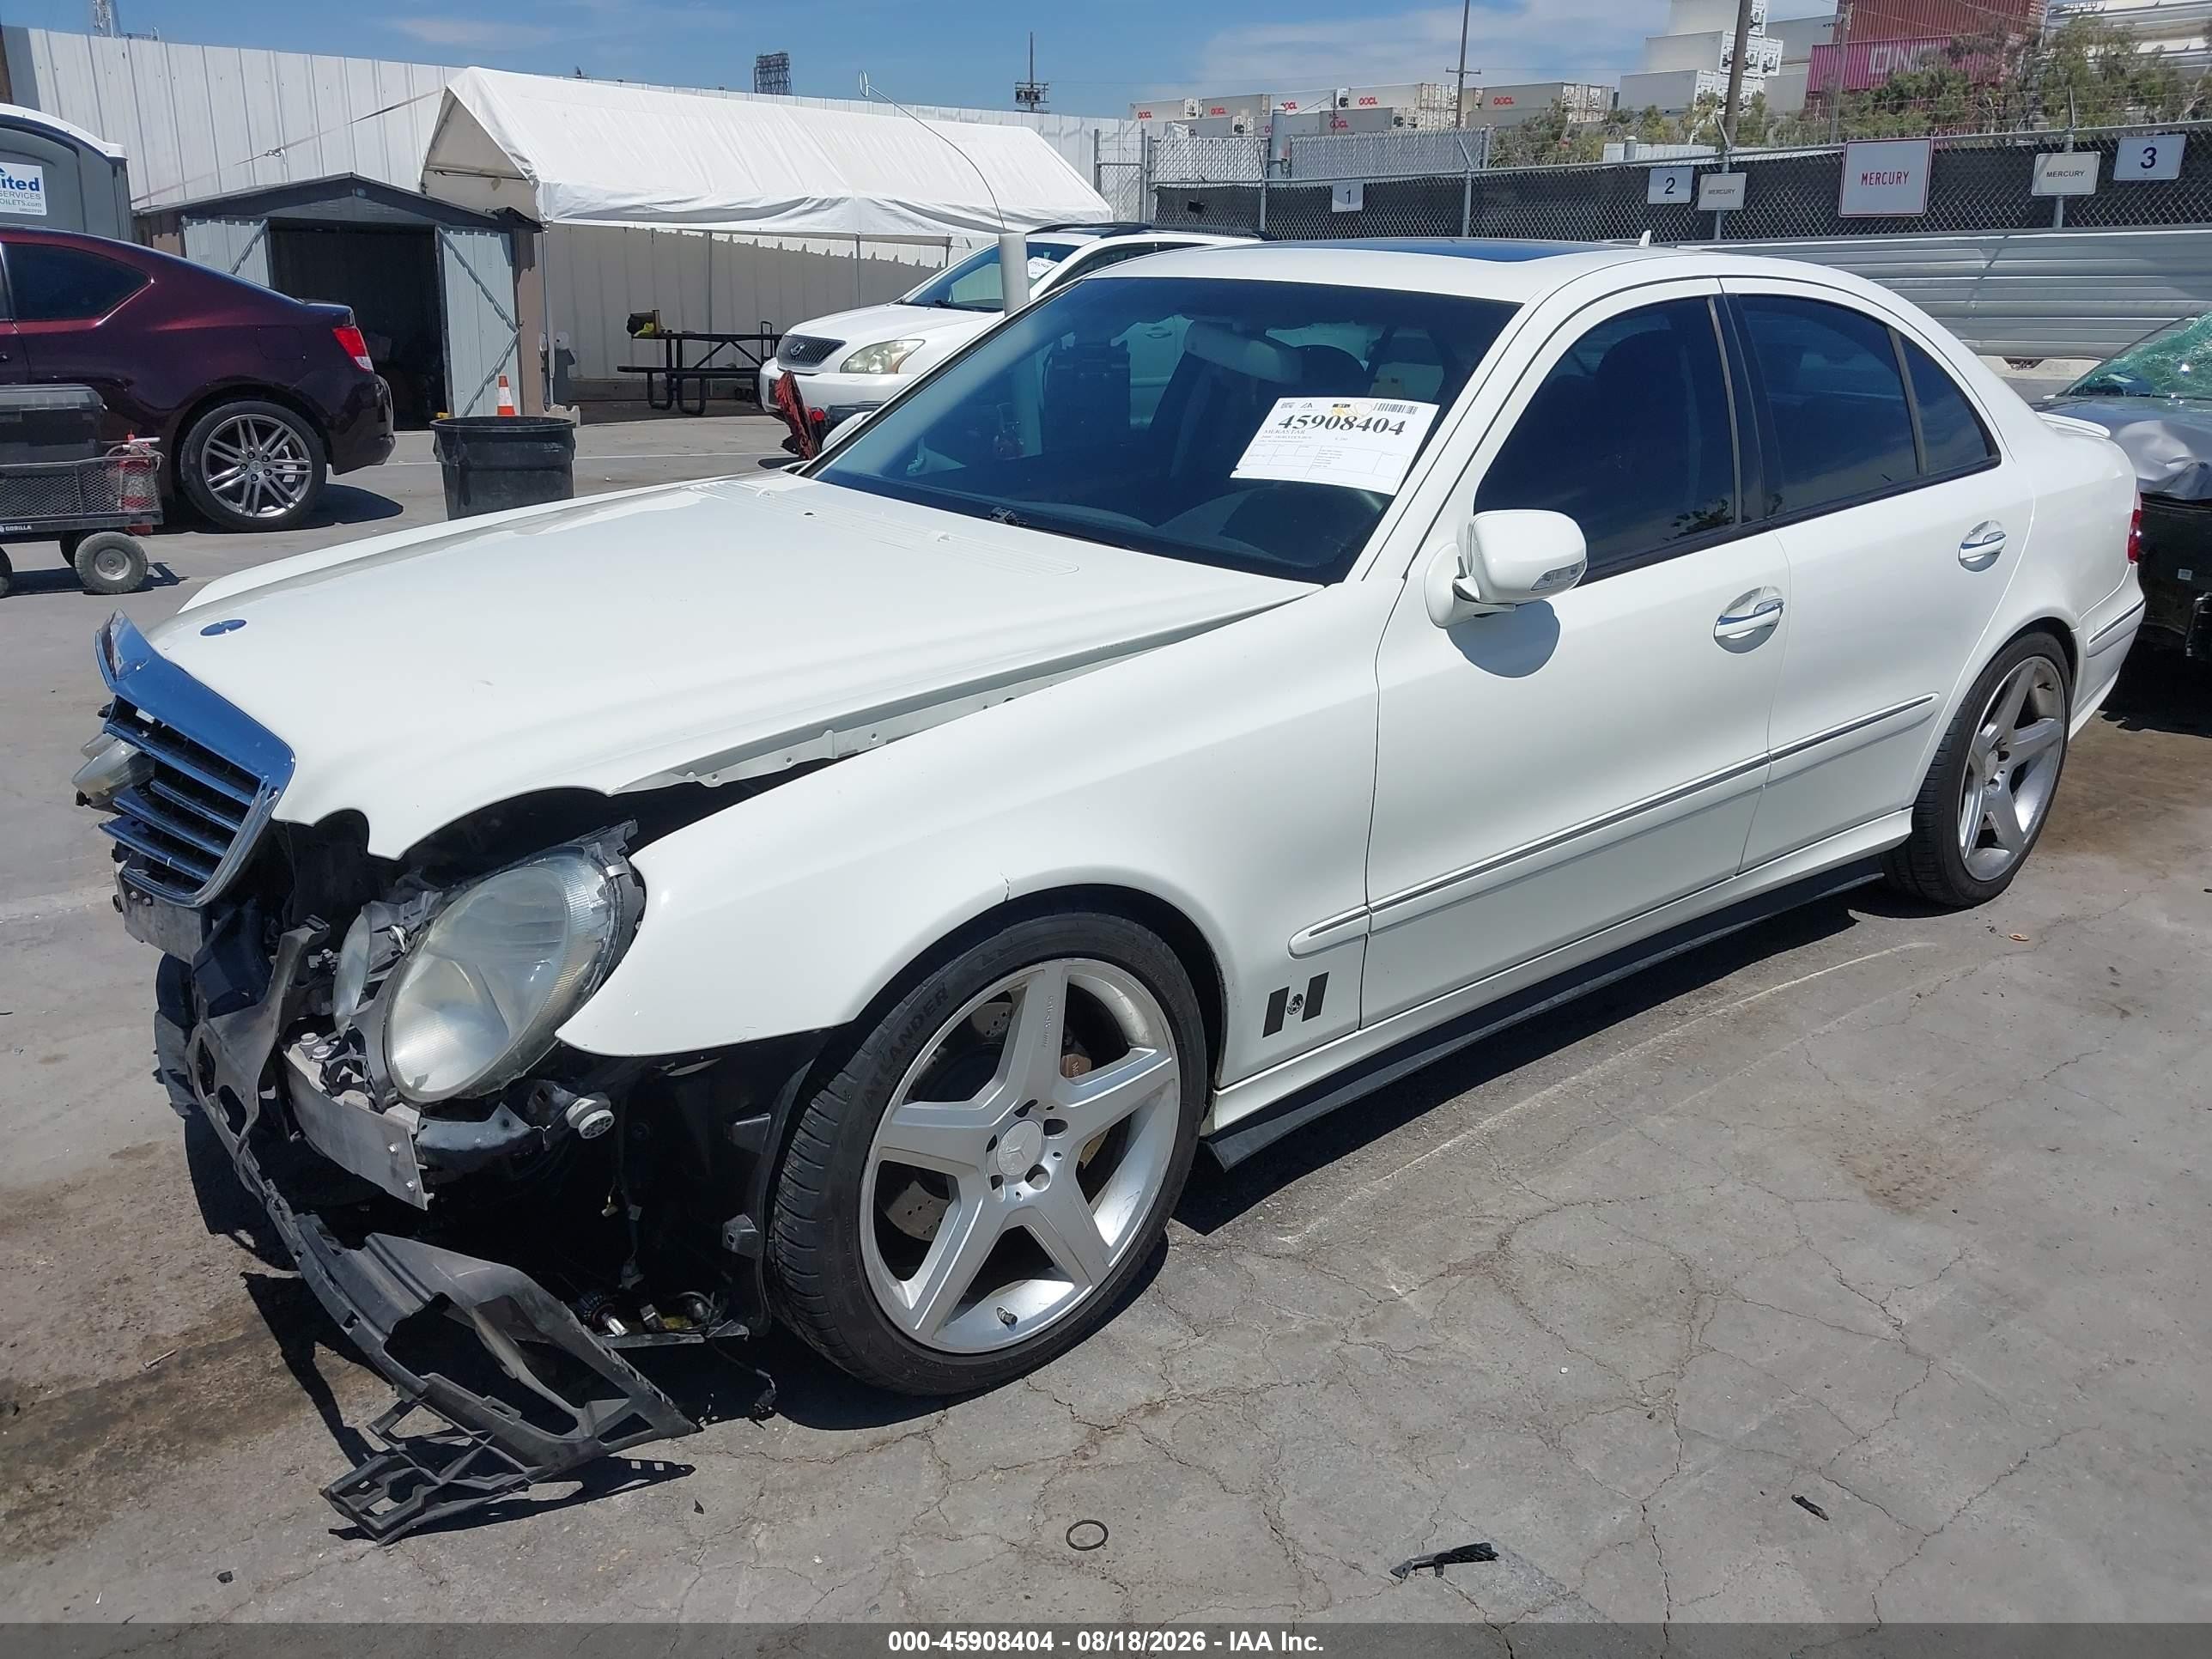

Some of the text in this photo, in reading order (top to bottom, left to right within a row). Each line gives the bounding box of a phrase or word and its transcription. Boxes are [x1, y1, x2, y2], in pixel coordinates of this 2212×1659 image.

[1358, 96, 1377, 106] OOCL
[1493, 96, 1515, 106] OOCL
[1138, 111, 1152, 119] OOCL
[2140, 147, 2157, 169] 3
[1861, 171, 1910, 186] MERCURY
[2046, 169, 2086, 178] MERCURY
[0, 174, 40, 191] ited
[1664, 177, 1676, 195] 2
[1346, 189, 1352, 205] 1
[1278, 415, 1407, 435] 45908404
